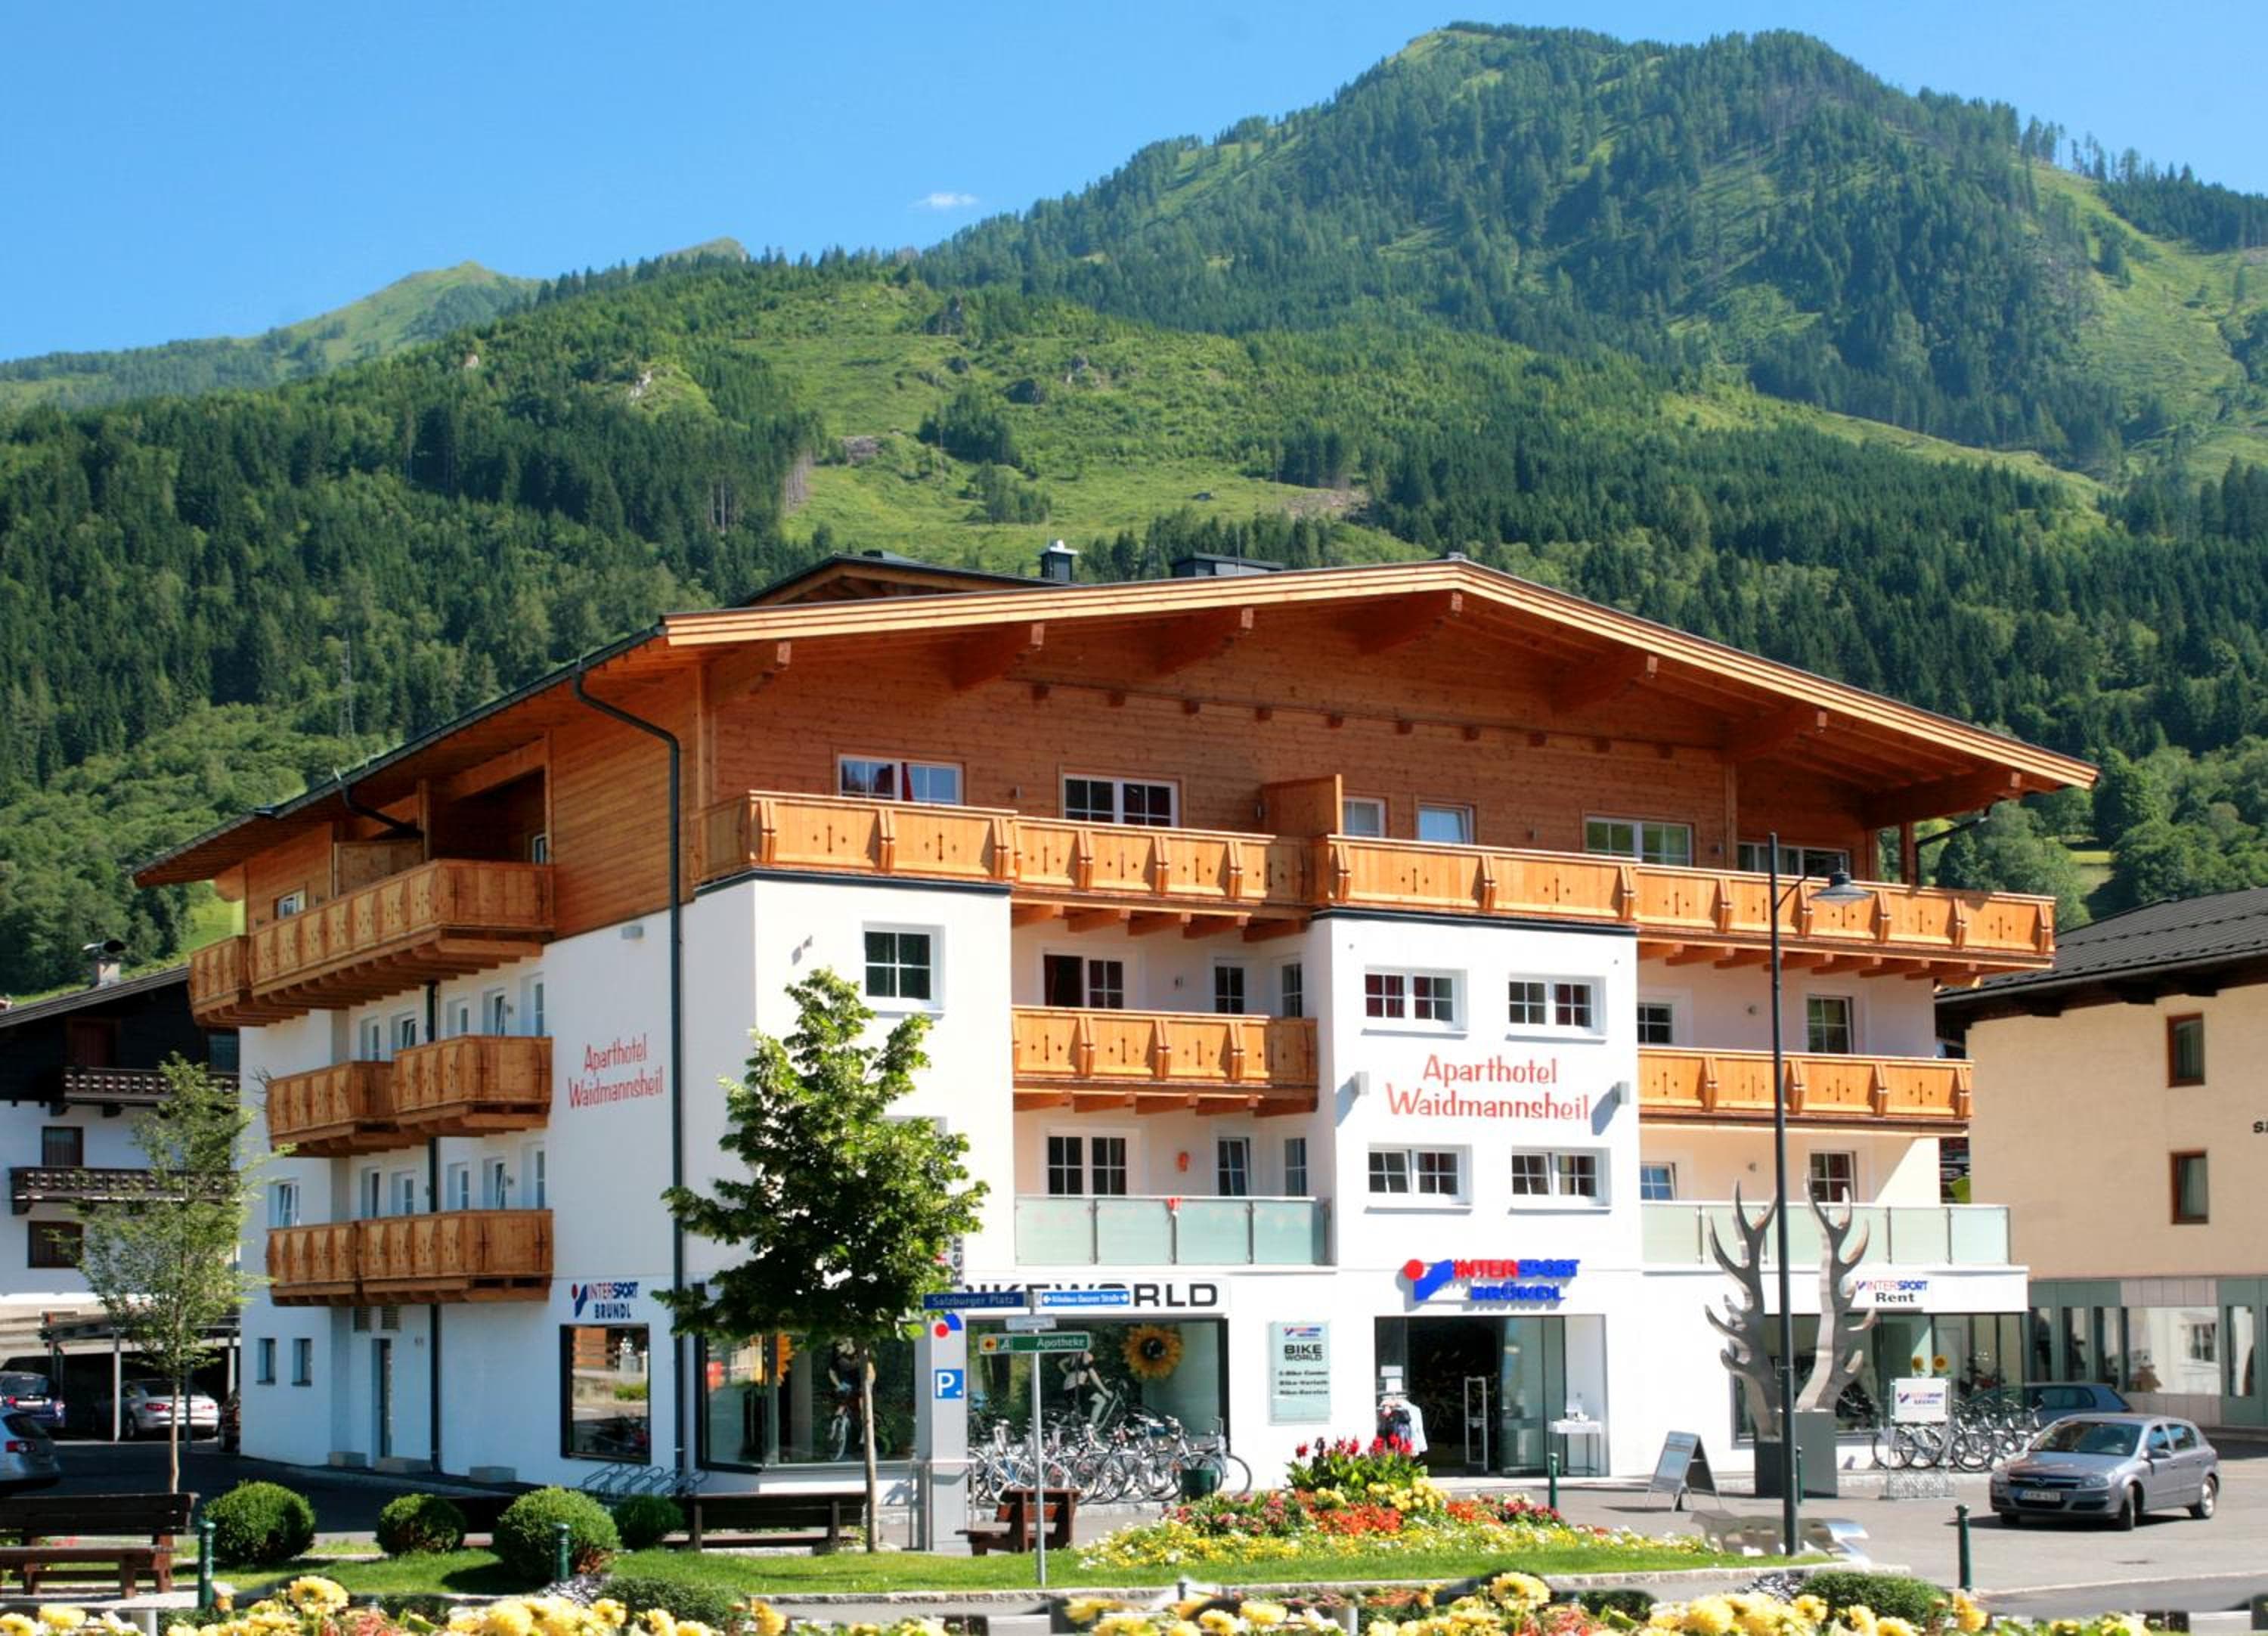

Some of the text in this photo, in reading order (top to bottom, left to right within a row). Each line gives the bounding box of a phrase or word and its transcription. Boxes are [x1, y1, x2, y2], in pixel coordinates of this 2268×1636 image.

[584, 1033, 646, 1076] Aparthotel
[1423, 1055, 1557, 1086] Aparthotel
[568, 1066, 663, 1108] Waidmannsheil
[1386, 1083, 1589, 1120] Waidmannsheil
[1452, 1259, 1580, 1278] INTERSPORT
[587, 1281, 639, 1300] INTERSPORT
[1866, 1280, 1928, 1291] INTERSPORT
[931, 1297, 986, 1307] Salzburger
[989, 1294, 1015, 1305] Platz
[1876, 1292, 1914, 1303] Rent
[1036, 1337, 1085, 1349] Apotheke
[1284, 1344, 1322, 1354] BIKE
